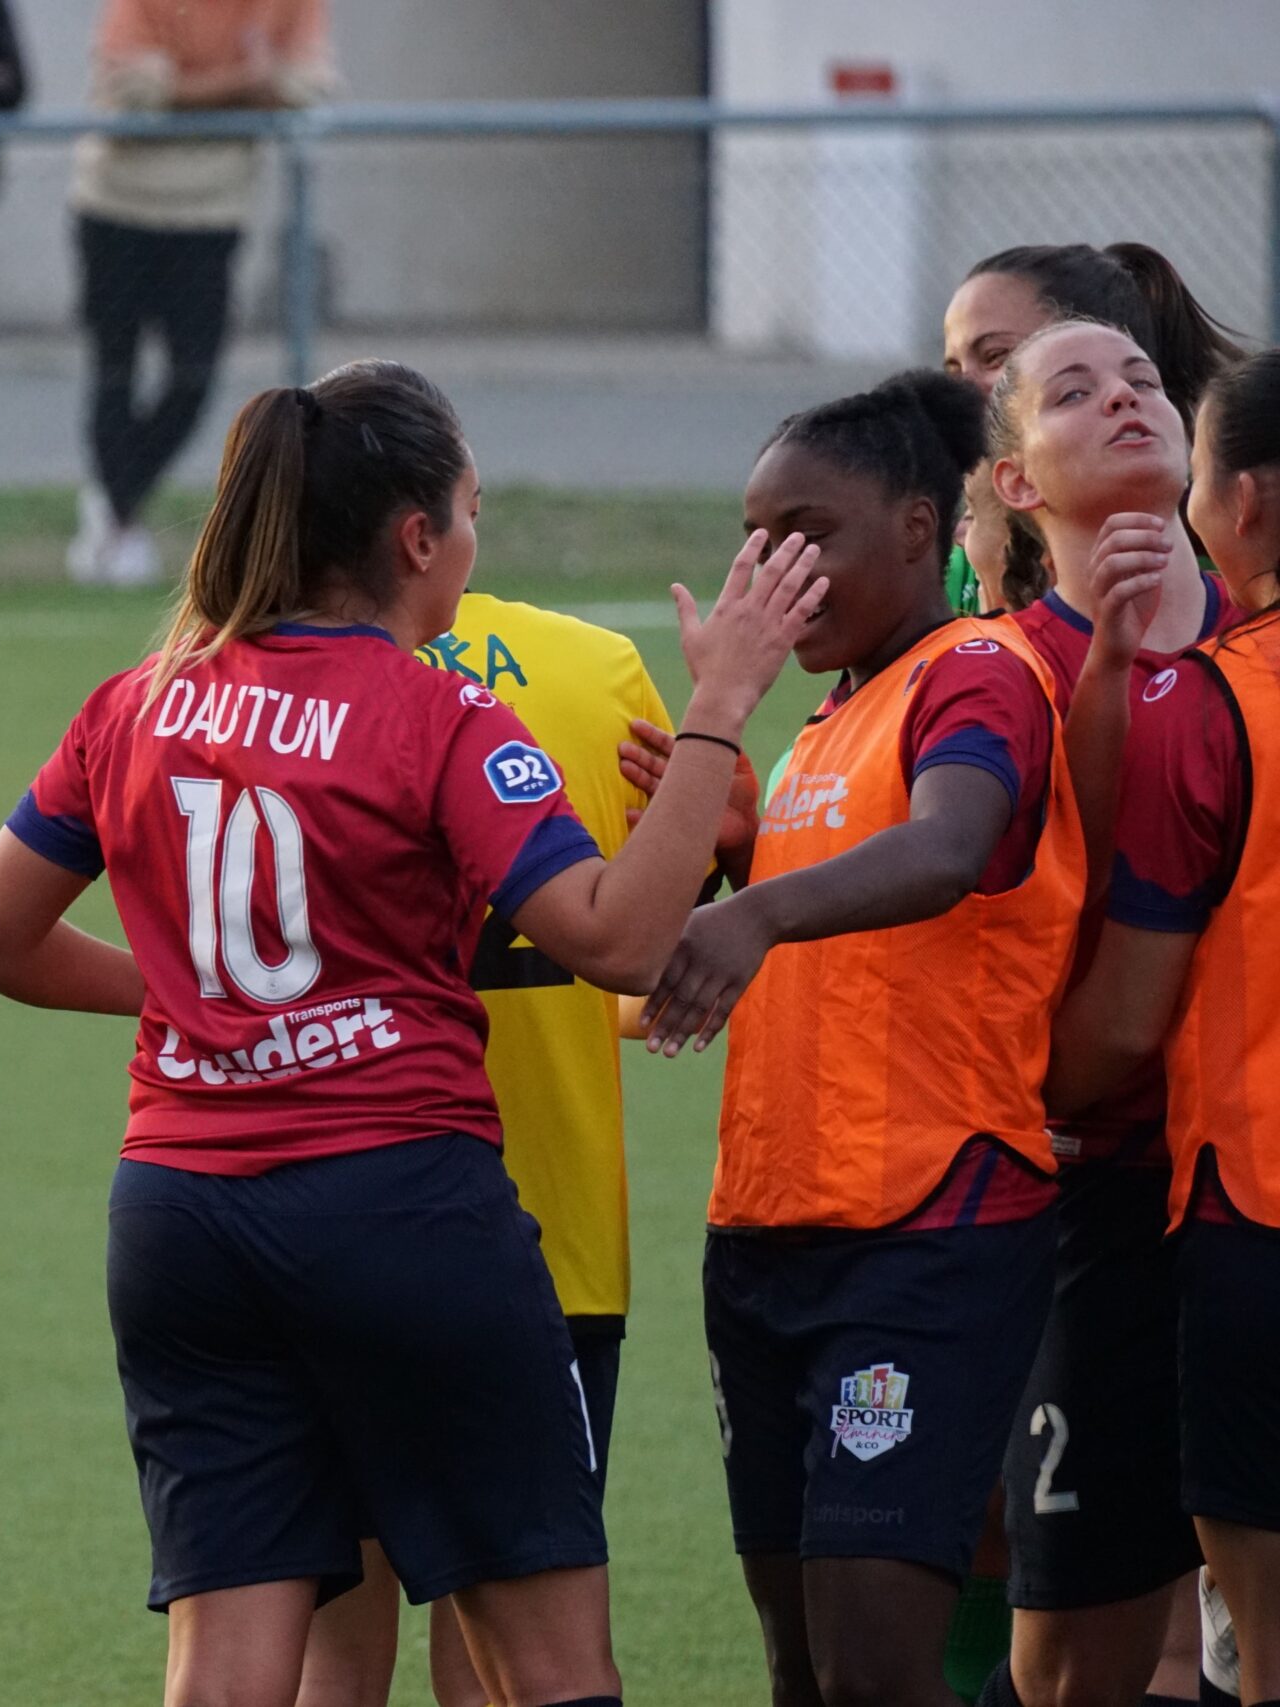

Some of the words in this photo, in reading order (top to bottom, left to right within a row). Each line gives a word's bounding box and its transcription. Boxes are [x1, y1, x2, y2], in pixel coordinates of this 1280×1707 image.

[153, 679, 351, 761] DAUTUN
[496, 755, 549, 788] D2
[170, 776, 322, 1005] 10
[287, 997, 361, 1024] Transports
[836, 1408, 909, 1429] SPORT
[1029, 1402, 1080, 1515] 2
